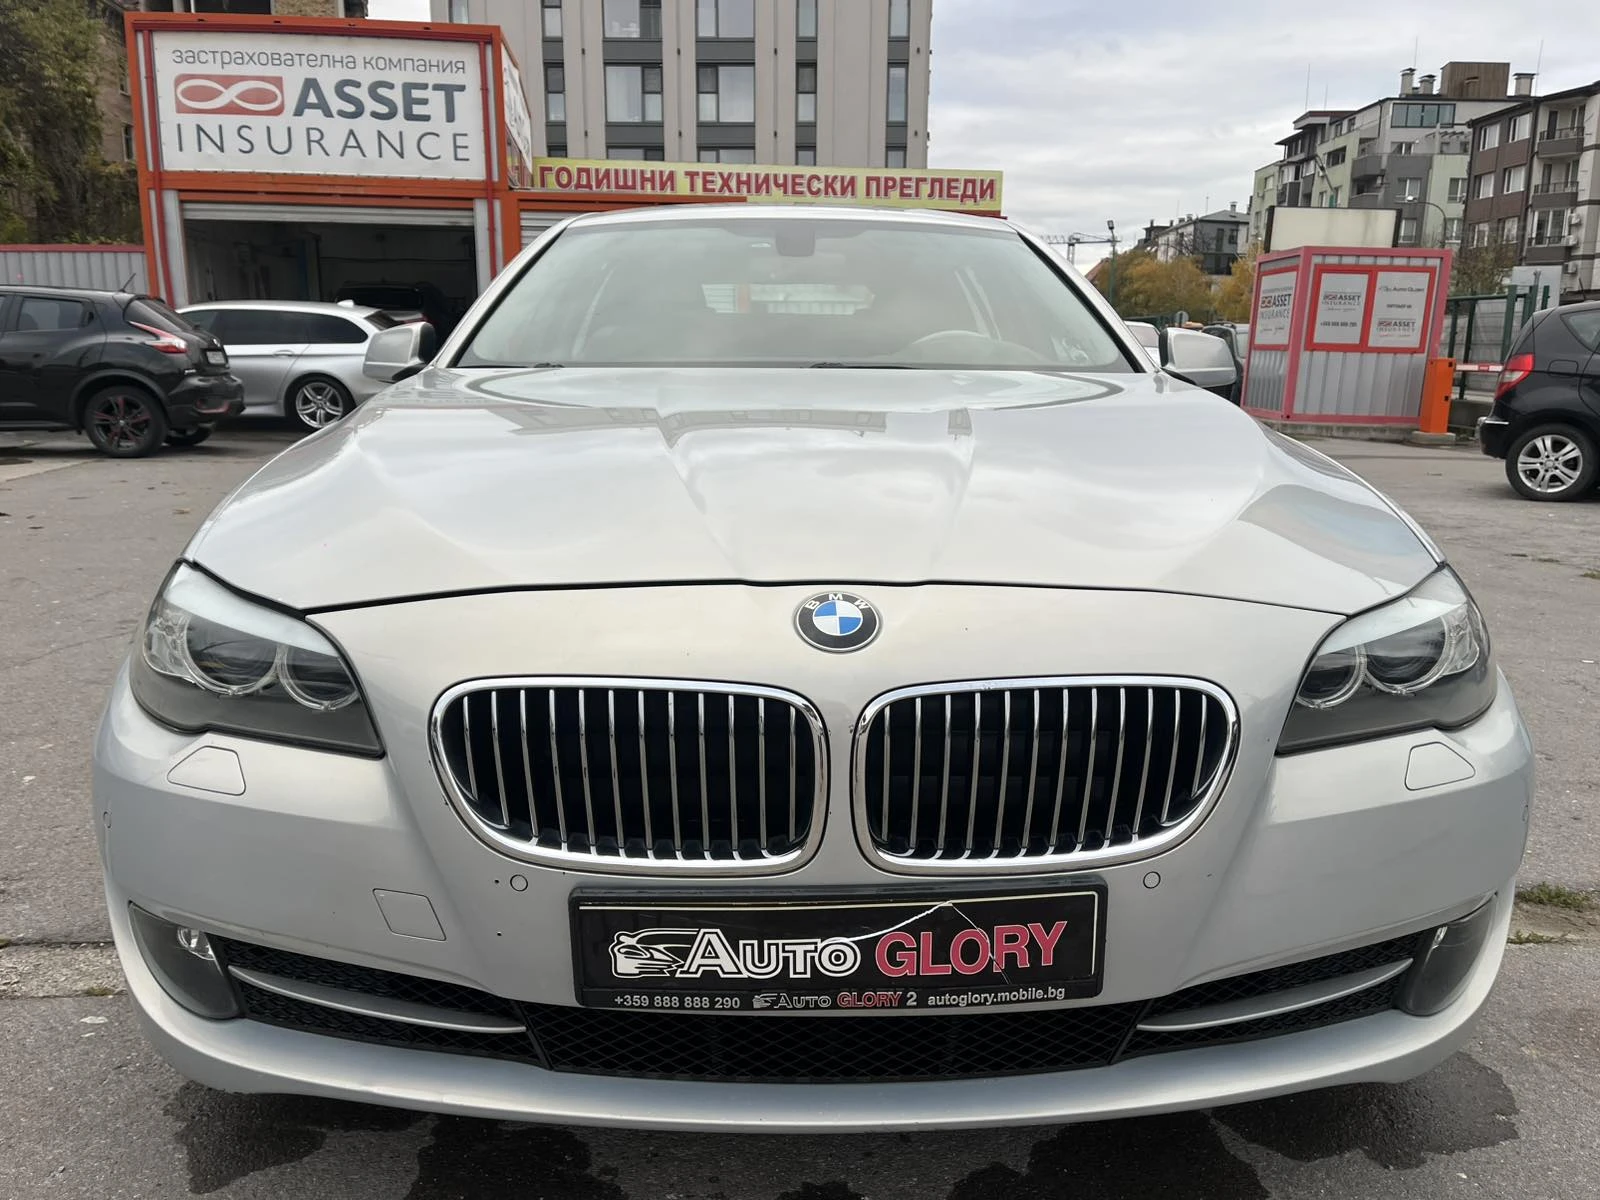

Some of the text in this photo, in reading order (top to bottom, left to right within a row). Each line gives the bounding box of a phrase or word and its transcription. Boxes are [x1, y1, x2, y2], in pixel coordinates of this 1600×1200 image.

[172, 48, 466, 75] застрахователна компания
[293, 77, 467, 123] ASSET
[177, 123, 471, 162] INSURANCE
[538, 165, 997, 204] ГОДИШНИ ТЕХНИЧЕСКИ ПРЕГЛЕДИ
[1273, 293, 1292, 308] ASSET
[804, 593, 869, 610] BMW
[874, 920, 1068, 977] GLORY
[614, 995, 649, 1007] +359
[654, 995, 680, 1008] 888
[684, 996, 710, 1009] 888
[714, 997, 741, 1009] 290
[836, 991, 903, 1008] GLORY
[906, 992, 918, 1006] 2
[927, 986, 1066, 1008] autoglory.mobile.bg
